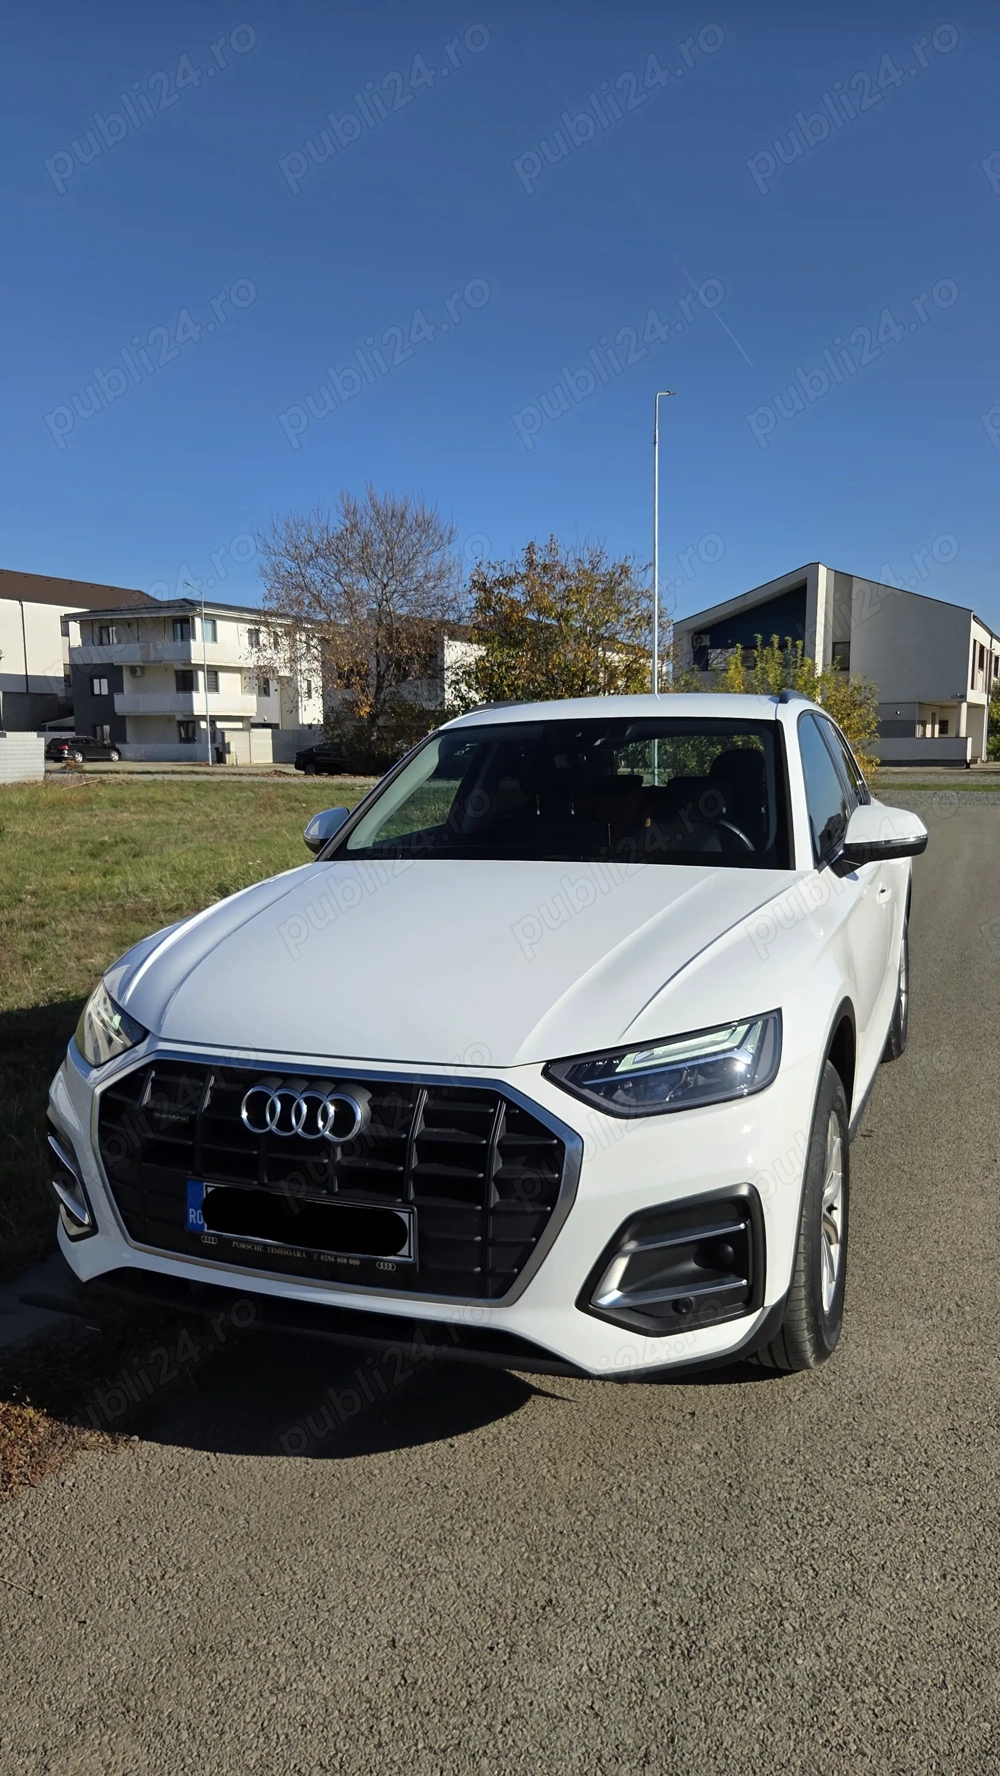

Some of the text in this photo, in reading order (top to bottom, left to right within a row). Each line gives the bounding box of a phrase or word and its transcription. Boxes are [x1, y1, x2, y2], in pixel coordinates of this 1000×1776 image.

[189, 1208, 204, 1224] RO
[232, 1241, 264, 1253] PORSCHE
[267, 1247, 307, 1258] TIMISOARA
[320, 1254, 335, 1263] 0256
